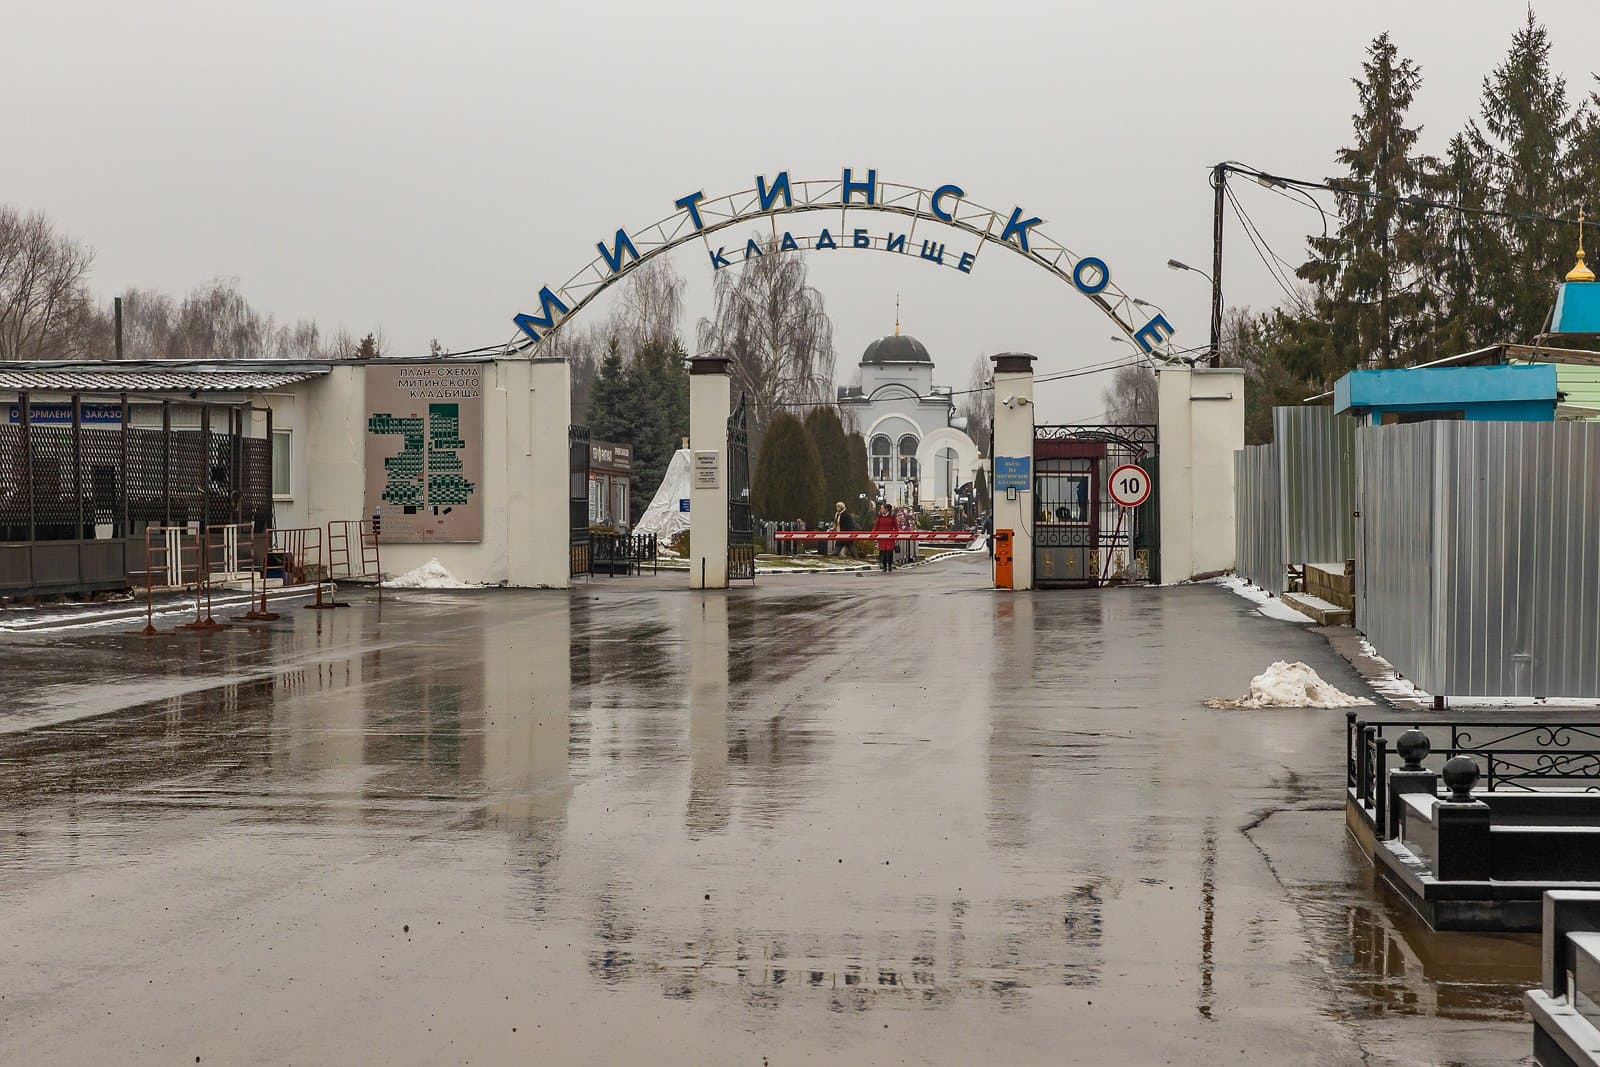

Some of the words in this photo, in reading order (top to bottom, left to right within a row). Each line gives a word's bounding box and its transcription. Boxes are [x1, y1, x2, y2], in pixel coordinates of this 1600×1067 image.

[708, 228, 977, 274] КЛАДБИЩЕ
[512, 167, 1176, 355] МИТИНСКОЕ
[400, 368, 479, 377] ПЛАН-СХЕМА
[398, 379, 480, 388] МИТИНСКОГО
[410, 389, 479, 398] КЛАДБИЩА
[11, 410, 74, 419] ООРМЛЕНИ
[85, 410, 123, 419] ЗАКАЗО
[1119, 477, 1140, 495] 10
